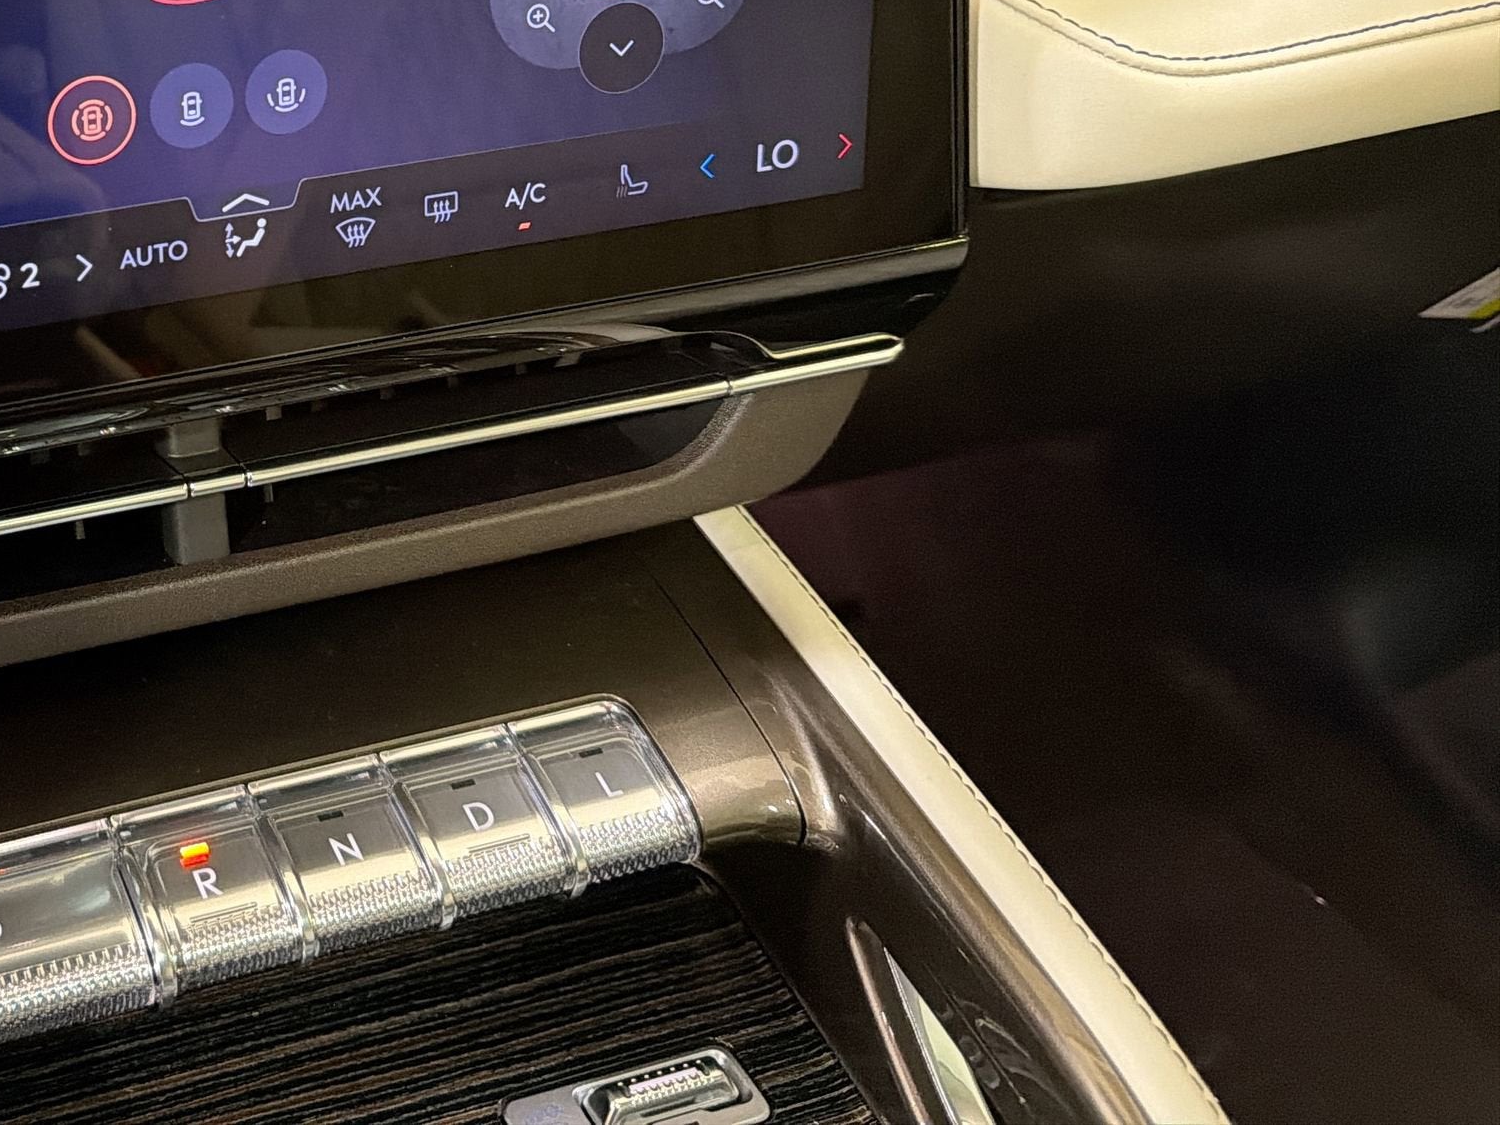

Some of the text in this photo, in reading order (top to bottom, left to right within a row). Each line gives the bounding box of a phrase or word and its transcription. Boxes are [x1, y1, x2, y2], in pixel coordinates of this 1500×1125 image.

[756, 138, 800, 174] LO
[330, 187, 383, 214] MAX
[504, 183, 547, 210] A/C
[119, 240, 189, 271] AUTO
[20, 263, 41, 289] 2
[594, 771, 624, 798] L
[462, 801, 494, 832] D
[329, 833, 362, 865] N
[192, 865, 224, 900] R
